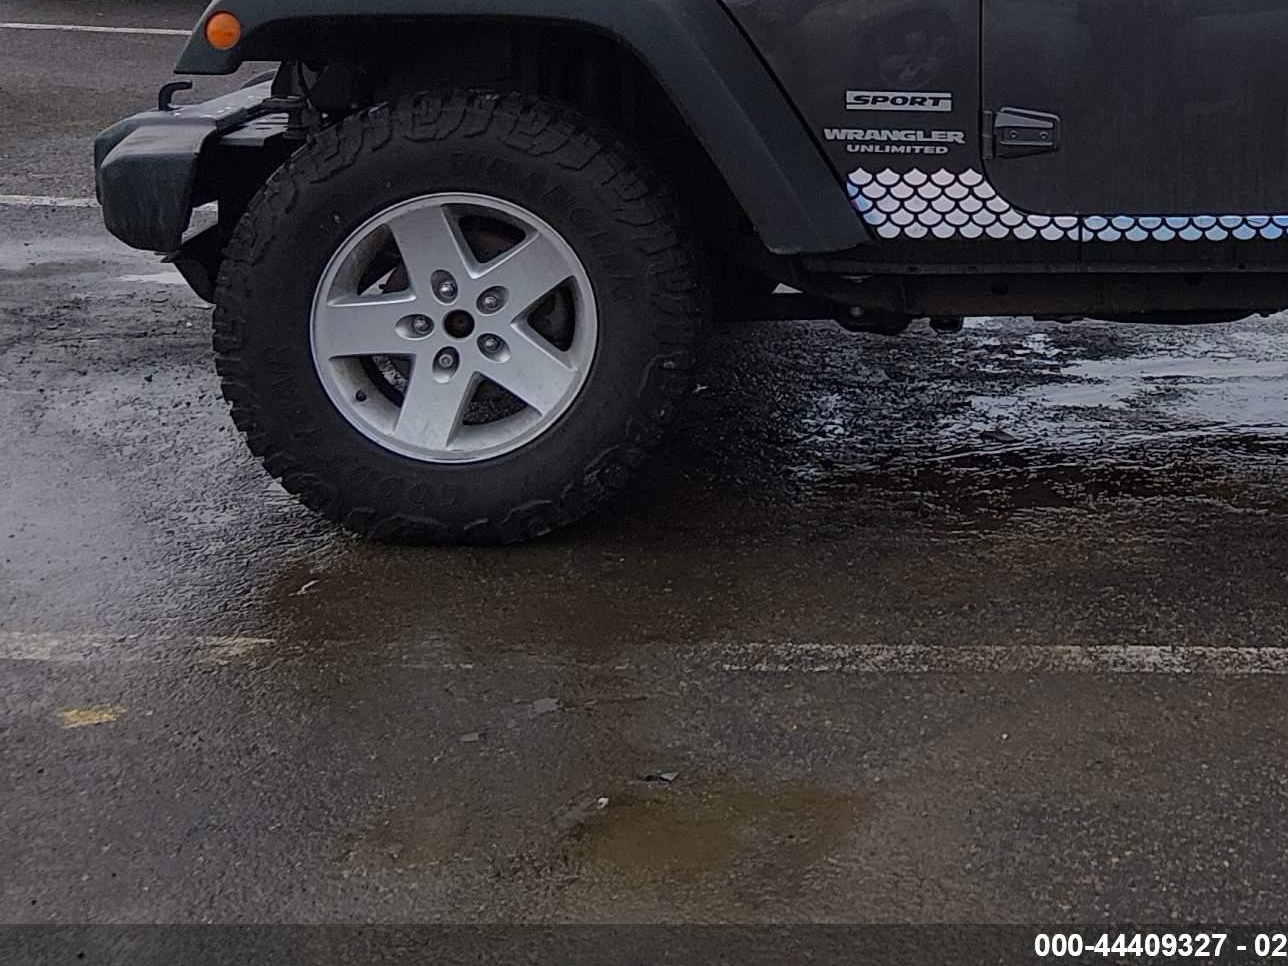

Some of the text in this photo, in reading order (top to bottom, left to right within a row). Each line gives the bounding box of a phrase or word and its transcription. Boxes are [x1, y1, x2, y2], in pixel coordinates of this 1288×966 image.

[847, 94, 951, 107] SPORT
[823, 128, 966, 144] WRANGLER
[846, 144, 949, 154] UNLIMITED
